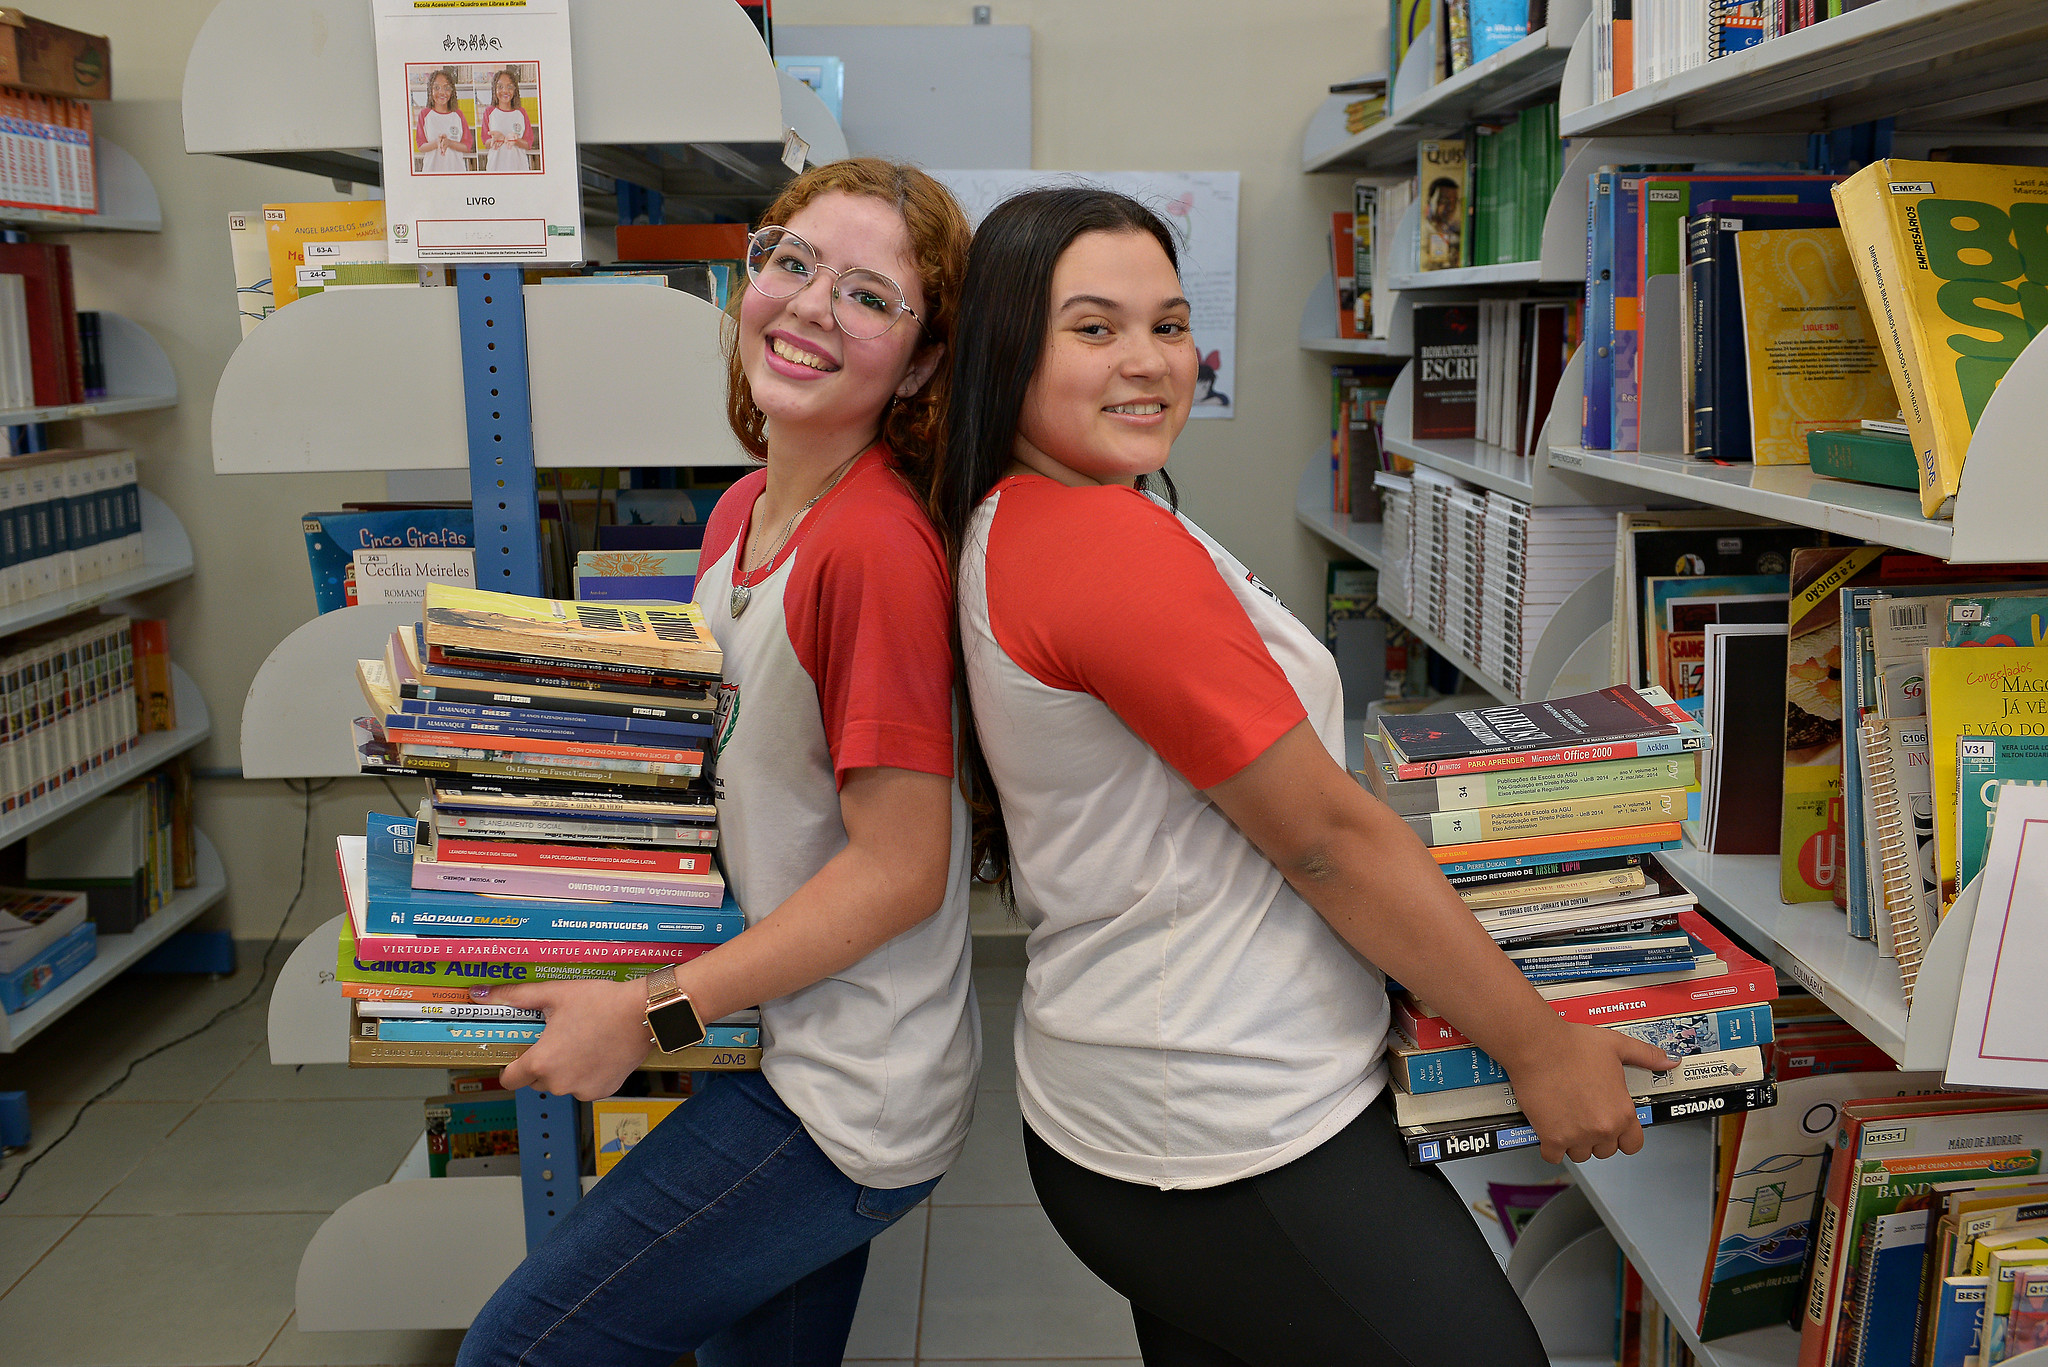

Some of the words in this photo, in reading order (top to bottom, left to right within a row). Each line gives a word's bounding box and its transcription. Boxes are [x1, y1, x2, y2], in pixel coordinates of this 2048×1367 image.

[1892, 184, 1922, 192] EMP4
[2014, 179, 2036, 188] Latif
[466, 197, 496, 206] LIVRO
[232, 219, 244, 228] 18
[320, 223, 356, 234] BARCELOS
[1905, 204, 1929, 271] EMPRESÁRIOS
[1867, 244, 1886, 289] EMPRESÁRIOS
[1880, 286, 1897, 331] BRASILEIROS
[1890, 329, 1908, 370] PREMIADOS
[304, 522, 320, 532] 201
[358, 528, 402, 548] Cinco
[406, 526, 468, 548] Girafas
[364, 562, 412, 578] Cecília
[415, 562, 470, 578] Meireles
[1805, 572, 1842, 604] EDIÇÃO
[1961, 608, 1976, 618] C7
[1966, 661, 2032, 690] Congelados
[437, 706, 476, 715] ALMANAQUE
[2002, 698, 2021, 719] JÁ
[426, 720, 466, 729] ALMANAQUE
[1977, 722, 2013, 736] VÃO
[2019, 722, 2046, 736] DO
[1902, 734, 1926, 744] C106
[566, 746, 584, 754] MÉDIO
[636, 750, 648, 758] PARA
[649, 751, 670, 760] ESPORTE
[1469, 746, 1511, 755] ROMANTICAMENTE
[1964, 745, 1985, 754] V31
[418, 758, 450, 768] OBJETIVO
[1424, 762, 1438, 776] 10
[1439, 763, 1461, 772] MINUTOS
[1468, 760, 1486, 768] PARA
[1488, 756, 1526, 766] APRENDER
[1531, 752, 1561, 763] Microsoft
[1564, 750, 1590, 762] Office
[1592, 746, 1613, 758] 2000
[1646, 742, 1670, 752] Acklen
[517, 766, 538, 775] Livros
[540, 768, 548, 776] da
[549, 768, 603, 780] Fuvest/Unicamp
[1496, 776, 1529, 785] Publicações
[1497, 782, 1535, 791] Pós-Graduação
[1560, 778, 1579, 786] Público
[1596, 774, 1610, 782] 2014
[1458, 786, 1469, 799] 34
[1512, 788, 1536, 796] Ambiental
[1541, 785, 1570, 794] Regulatório
[1491, 812, 1524, 820] Publicações
[1532, 808, 1550, 816] Escola
[1558, 806, 1572, 814] AGU
[1492, 816, 1530, 826] Pós-Graduação
[1556, 812, 1574, 820] Público
[479, 819, 534, 829] PLANEJAMENTO
[537, 822, 562, 830] SOCIAL
[1454, 820, 1463, 832] 34
[1504, 822, 1538, 832] Administrativo
[551, 854, 588, 862] POLITICAMENTE
[620, 856, 640, 864] AMÉRICA
[640, 858, 656, 866] LATINA
[1486, 860, 1508, 870] DUKAN
[1488, 870, 1522, 879] RETORNO
[1523, 868, 1534, 876] DE
[1561, 861, 1582, 872] LUPIN
[568, 882, 611, 892] CONSUMO
[620, 885, 646, 896] MÍDIA
[648, 886, 710, 899] COMUNICAÇÃO,
[1498, 906, 1523, 917] HISTÓRIAS
[1540, 902, 1560, 911] JORNAIS
[1570, 897, 1589, 907] CONTAM
[412, 912, 436, 922] SÃO
[436, 916, 472, 924] PAULO
[474, 916, 492, 924] EM
[492, 915, 519, 926] AÇÃO
[551, 918, 588, 929] LÍNGUA
[589, 921, 649, 931] PORTUGUESA
[382, 945, 441, 954] VIRTUDE
[446, 946, 453, 954] E
[458, 944, 530, 955] APARÊNCIA
[540, 948, 580, 956] VIRTUE
[584, 948, 609, 956] AND
[612, 948, 684, 958] APPEARANCE
[444, 962, 528, 980] Aulete
[535, 965, 582, 975] DICIONÁRIO
[582, 968, 617, 977] ESCOLAR
[548, 972, 572, 980] LÍNGUA
[1792, 964, 1824, 998] CULINÁRIA
[358, 987, 381, 996] Adas
[382, 988, 414, 998] Sérgio
[421, 1006, 444, 1014] 2013
[450, 1006, 542, 1020] Bioeletricidade
[1588, 1000, 1647, 1016] MATEMÁTICA
[450, 1028, 541, 1040] PAULISTA
[384, 1049, 406, 1057] anos
[1471, 1050, 1479, 1070] PAULO
[1684, 1066, 1711, 1078] PAULO
[1712, 1064, 1728, 1074] SÃO
[1670, 1097, 1725, 1118] ESTADÃO
[1446, 1132, 1490, 1154] Help!
[1500, 1137, 1528, 1147] Consulta
[1868, 1132, 1902, 1143] Q153-1
[1948, 1135, 1974, 1150] MÁRIO
[1974, 1138, 1984, 1147] DE
[1984, 1134, 2023, 1148] ANDRADE
[1864, 1174, 1884, 1184] Q04
[1972, 1220, 1992, 1231] Q85
[1809, 1278, 1826, 1320] BELEZA
[1822, 1205, 1836, 1268] JUVENTUDE
